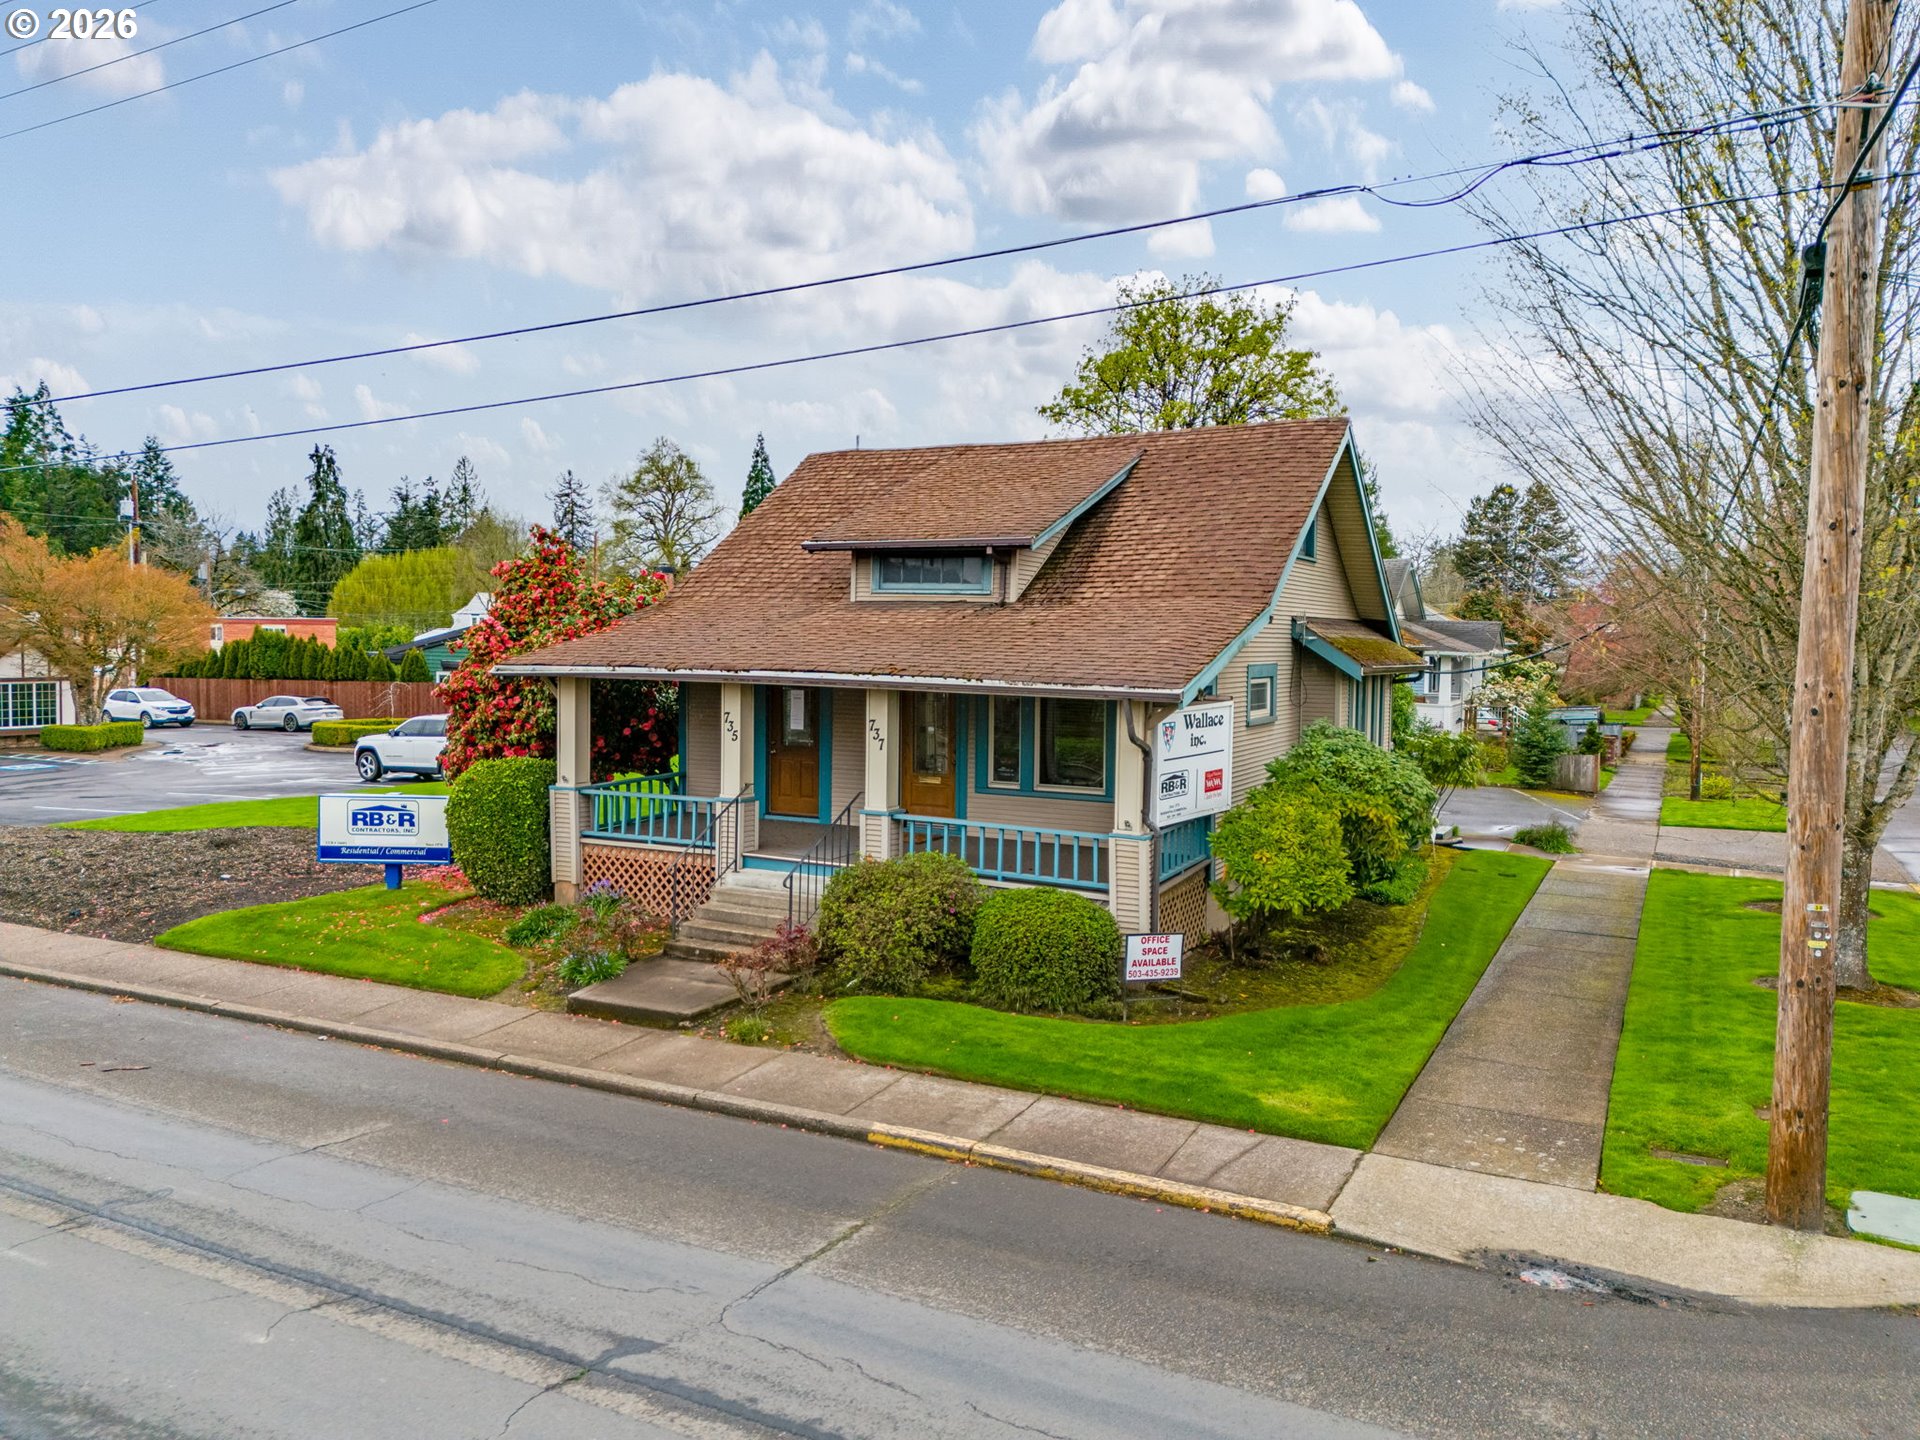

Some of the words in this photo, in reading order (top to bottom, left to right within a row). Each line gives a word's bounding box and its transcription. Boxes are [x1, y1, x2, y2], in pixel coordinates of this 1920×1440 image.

[723, 711, 739, 742] 735
[1183, 712, 1224, 730] Wallace
[868, 719, 885, 751] 737
[1190, 733, 1207, 748] inc.
[1161, 778, 1187, 794] RB&R
[352, 811, 416, 827] RB&R
[340, 846, 379, 855] Residential
[385, 847, 428, 856] Commercial
[1141, 935, 1170, 944] OFFICE
[1141, 946, 1168, 956] SPACE
[1131, 957, 1177, 967] AVAILABLE
[1128, 968, 1179, 978] 503-435-9239
